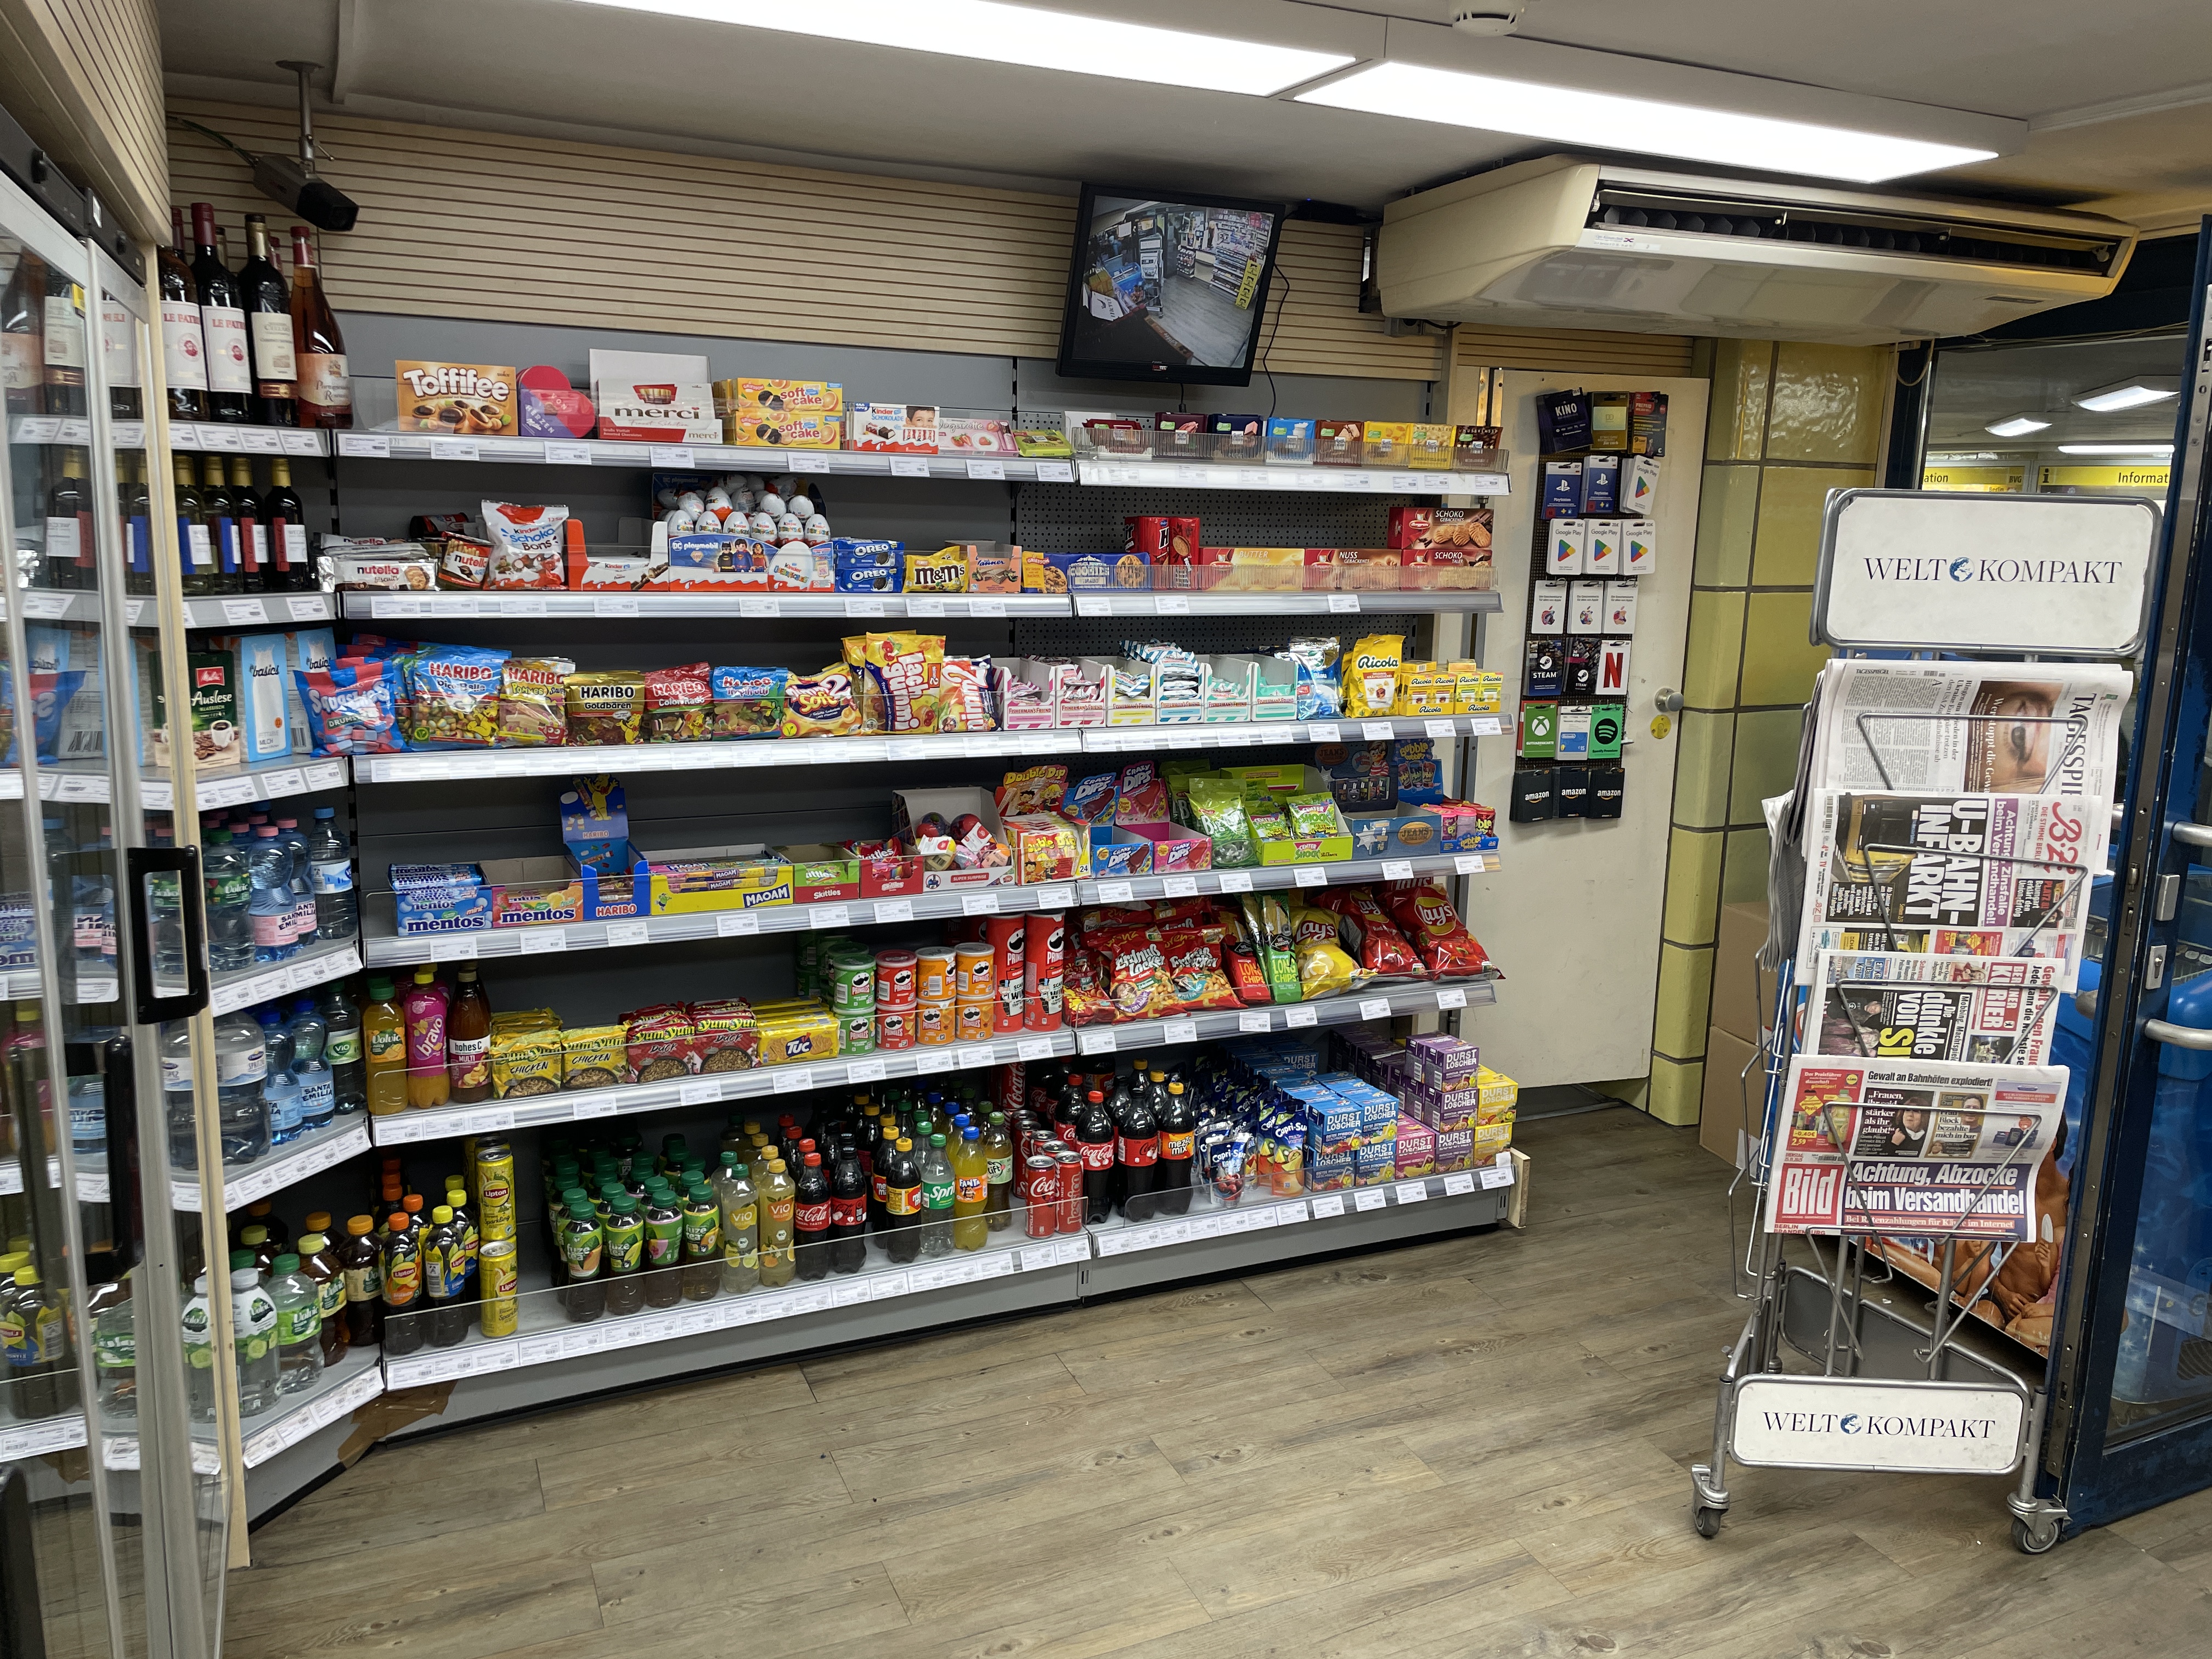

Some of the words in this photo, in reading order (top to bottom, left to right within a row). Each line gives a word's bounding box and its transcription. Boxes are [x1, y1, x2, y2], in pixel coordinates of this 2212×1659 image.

[403, 368, 510, 401] Toffifee
[780, 388, 805, 400] soft
[793, 395, 822, 405] cake
[551, 393, 567, 410] VON
[615, 407, 700, 420] merci
[1555, 403, 1577, 416] KINO
[526, 404, 555, 434] HERZEN
[778, 420, 804, 432] soft
[791, 427, 820, 439] cake
[2118, 472, 2168, 483] Informat
[1435, 510, 1464, 518] SCHOKO
[510, 528, 554, 544] Schoko
[522, 540, 552, 551] Bons
[673, 540, 682, 550] DC
[684, 541, 719, 550] playmobil
[854, 543, 889, 556] OREO
[357, 565, 399, 575] nutella
[851, 569, 887, 582] OREO
[915, 565, 964, 585] m&m's
[1864, 558, 1948, 581] WELT
[1977, 560, 2123, 584] KOMPAKT
[1358, 656, 1399, 670] Ricola
[430, 663, 492, 680] HARIBO
[1435, 677, 1454, 685] Ricola
[1460, 675, 1479, 684] Ricola
[581, 686, 635, 699] HARIBO
[652, 681, 706, 697] HARIBO
[191, 691, 233, 707] Auslese
[584, 701, 631, 710] Goldbären
[1419, 706, 1442, 714] Ricola
[1468, 703, 1490, 712] Ricola
[1318, 748, 1344, 760] JEANS
[1126, 764, 1150, 775] CRAZY
[1005, 772, 1045, 785] Double
[1046, 768, 1066, 779] Dip
[1084, 776, 1109, 785] CRAZY
[1122, 770, 1152, 793] DIPS
[1075, 782, 1109, 800] DIPS
[1525, 791, 1549, 801] amazon
[1561, 788, 1586, 796] amazon
[583, 830, 609, 839] HARIBO
[1401, 828, 1429, 838] JEANS
[1113, 847, 1131, 856] CRAZY
[1172, 842, 1190, 852] CRAZY
[1108, 851, 1131, 868] DIPS
[1168, 847, 1190, 864] DIPS
[1294, 849, 1320, 860] SHOCK
[1905, 804, 1952, 919] INFARKT
[1940, 800, 1987, 924] U-BAHN-
[715, 870, 737, 878] MAOAM
[710, 879, 732, 889] MAOAM
[882, 881, 904, 890] Skittles
[746, 887, 787, 907] MAOAM
[814, 889, 841, 899] Skittles
[466, 905, 483, 916] mint
[501, 908, 575, 924] mentos
[596, 904, 637, 917] HARIBO
[1420, 903, 1453, 926] Lay's
[407, 916, 484, 933] mentos
[1295, 921, 1335, 940] Lay's
[972, 973, 990, 983] PRINGLES
[1274, 973, 1297, 983] CHIPS
[2030, 966, 2042, 984] Jede
[852, 985, 870, 995] PRINGLES
[894, 982, 912, 992] PRINGLES
[2023, 1008, 2034, 1020] die
[922, 1021, 941, 1030] PRINGLES
[962, 1019, 981, 1029] PRINGLES
[1913, 992, 1953, 1054] dunkle
[372, 1034, 400, 1043] Volvic
[421, 1017, 443, 1056] bravo
[715, 1034, 742, 1042] DUCK
[849, 1030, 868, 1041] PRINGLES
[884, 1028, 904, 1037] PRINGLES
[335, 1043, 349, 1052] ViO
[455, 1042, 476, 1051] hohes
[477, 1041, 482, 1049] C
[650, 1043, 676, 1053] DUCK
[787, 1039, 810, 1054] TUC
[572, 1053, 611, 1064] CHICKEN
[1446, 1049, 1477, 1063] DURST
[510, 1062, 549, 1074] CHICKEN
[1869, 1071, 1895, 1081] Gewalt
[1908, 1073, 1951, 1084] Bahnhöfen
[1951, 1076, 1993, 1086] explodiert!
[304, 1084, 331, 1096] SANTA
[1482, 1086, 1515, 1098] DURST
[302, 1091, 333, 1102] EMILIA
[1444, 1091, 1476, 1104] DURST
[1364, 1102, 1397, 1115] DURST
[1327, 1111, 1361, 1125] DURST
[1439, 1131, 1472, 1144] DURST
[1478, 1126, 1509, 1138] DURST
[1399, 1136, 1432, 1149] DURST
[1171, 1147, 1188, 1155] mix
[1360, 1143, 1393, 1156] DURST
[1848, 1163, 1931, 1186] Achtung,
[1934, 1164, 2018, 1186] Abzocke
[484, 1188, 507, 1198] Lipton
[1782, 1168, 1837, 1215] Bild
[1845, 1187, 1892, 1210] beim
[1894, 1187, 2024, 1215] Versandhandel
[770, 1204, 790, 1214] ViO
[484, 1215, 510, 1224] Sparkling
[732, 1211, 752, 1222] ViO
[686, 1224, 707, 1235] fuze
[567, 1245, 590, 1255] fuze
[608, 1240, 630, 1251] fuze
[568, 1252, 584, 1261] tea
[610, 1249, 624, 1257] tea
[394, 1267, 415, 1278] Lipton
[1763, 1412, 1838, 1433] WELT
[1866, 1417, 1995, 1438] KOMPAKT
